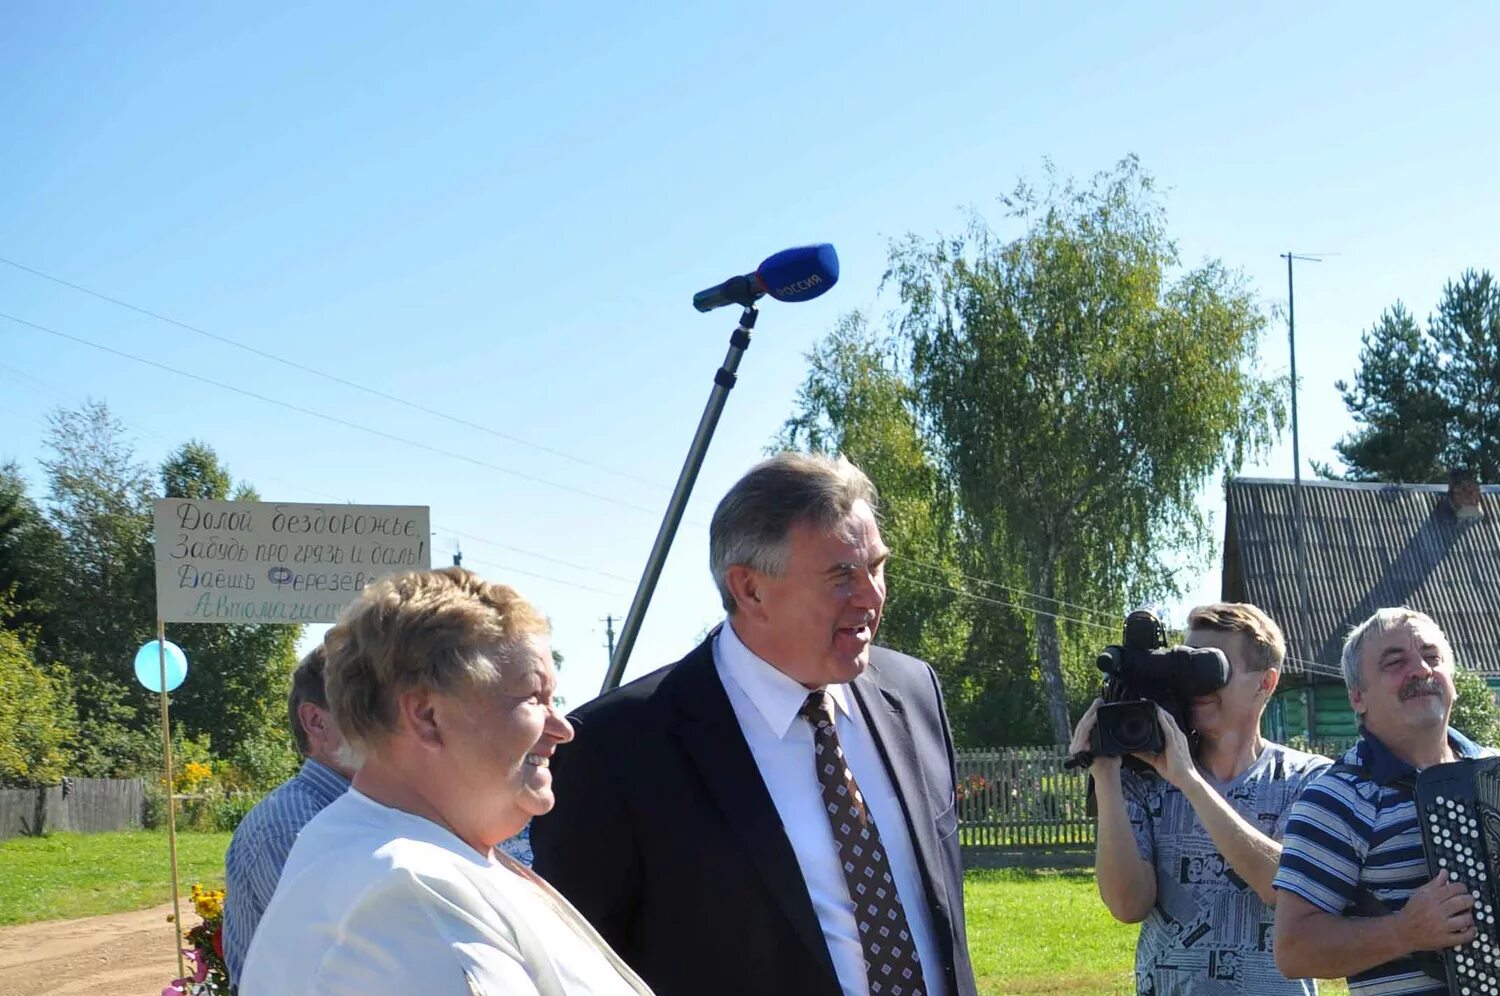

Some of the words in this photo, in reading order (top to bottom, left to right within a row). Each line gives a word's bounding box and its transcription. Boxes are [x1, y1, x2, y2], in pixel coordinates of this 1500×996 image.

[776, 274, 823, 297] РОССИЯ
[177, 502, 253, 532] Долой
[272, 504, 421, 539] бездорожье,
[170, 534, 248, 561] Забудь
[256, 543, 288, 563] про
[294, 544, 343, 565] грязь
[350, 545, 365, 564] и
[371, 541, 423, 565] даль!
[177, 564, 255, 590] Даёшь
